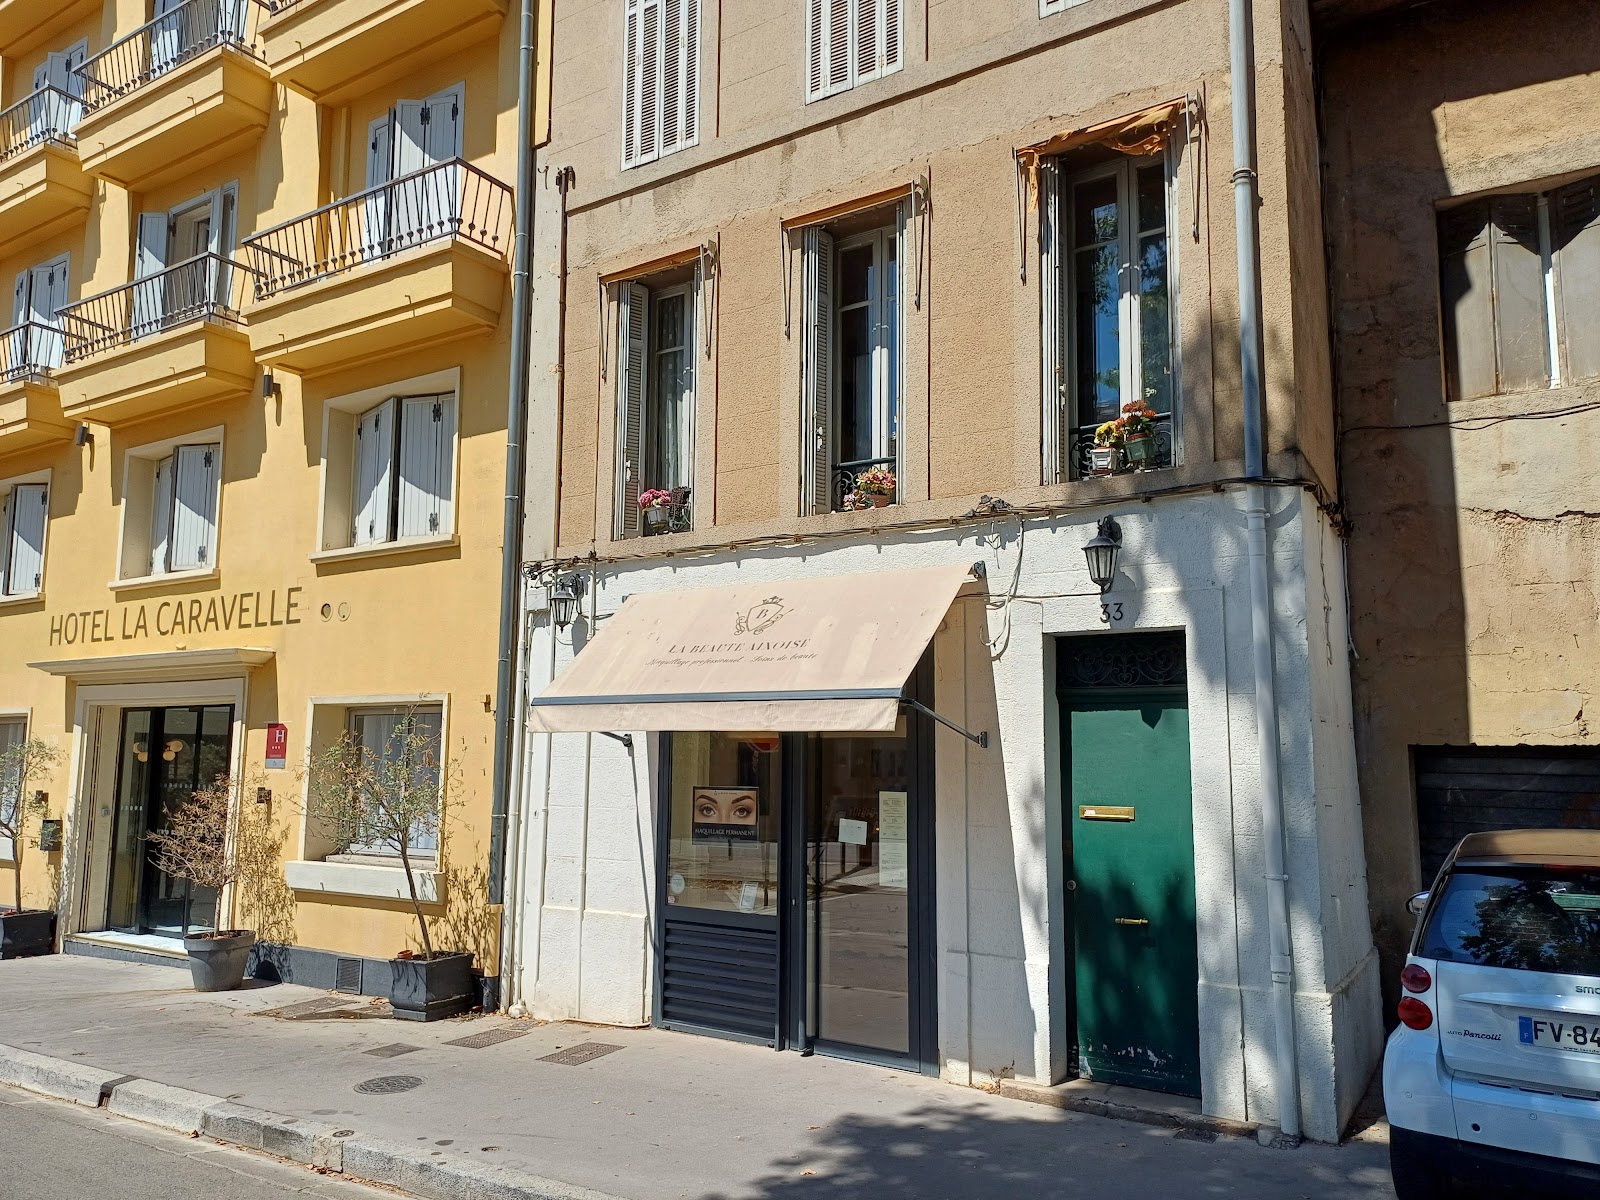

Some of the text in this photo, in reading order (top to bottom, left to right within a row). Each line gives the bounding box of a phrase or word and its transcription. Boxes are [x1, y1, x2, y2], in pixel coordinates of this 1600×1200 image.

[49, 586, 303, 647] HOTEL LA CARAVELLE
[1099, 602, 1124, 624] 33
[668, 644, 686, 654] LA
[745, 638, 811, 651] AIXOISE
[275, 729, 285, 743] H
[694, 828, 755, 837] MAQUILLAGE PERMANENT
